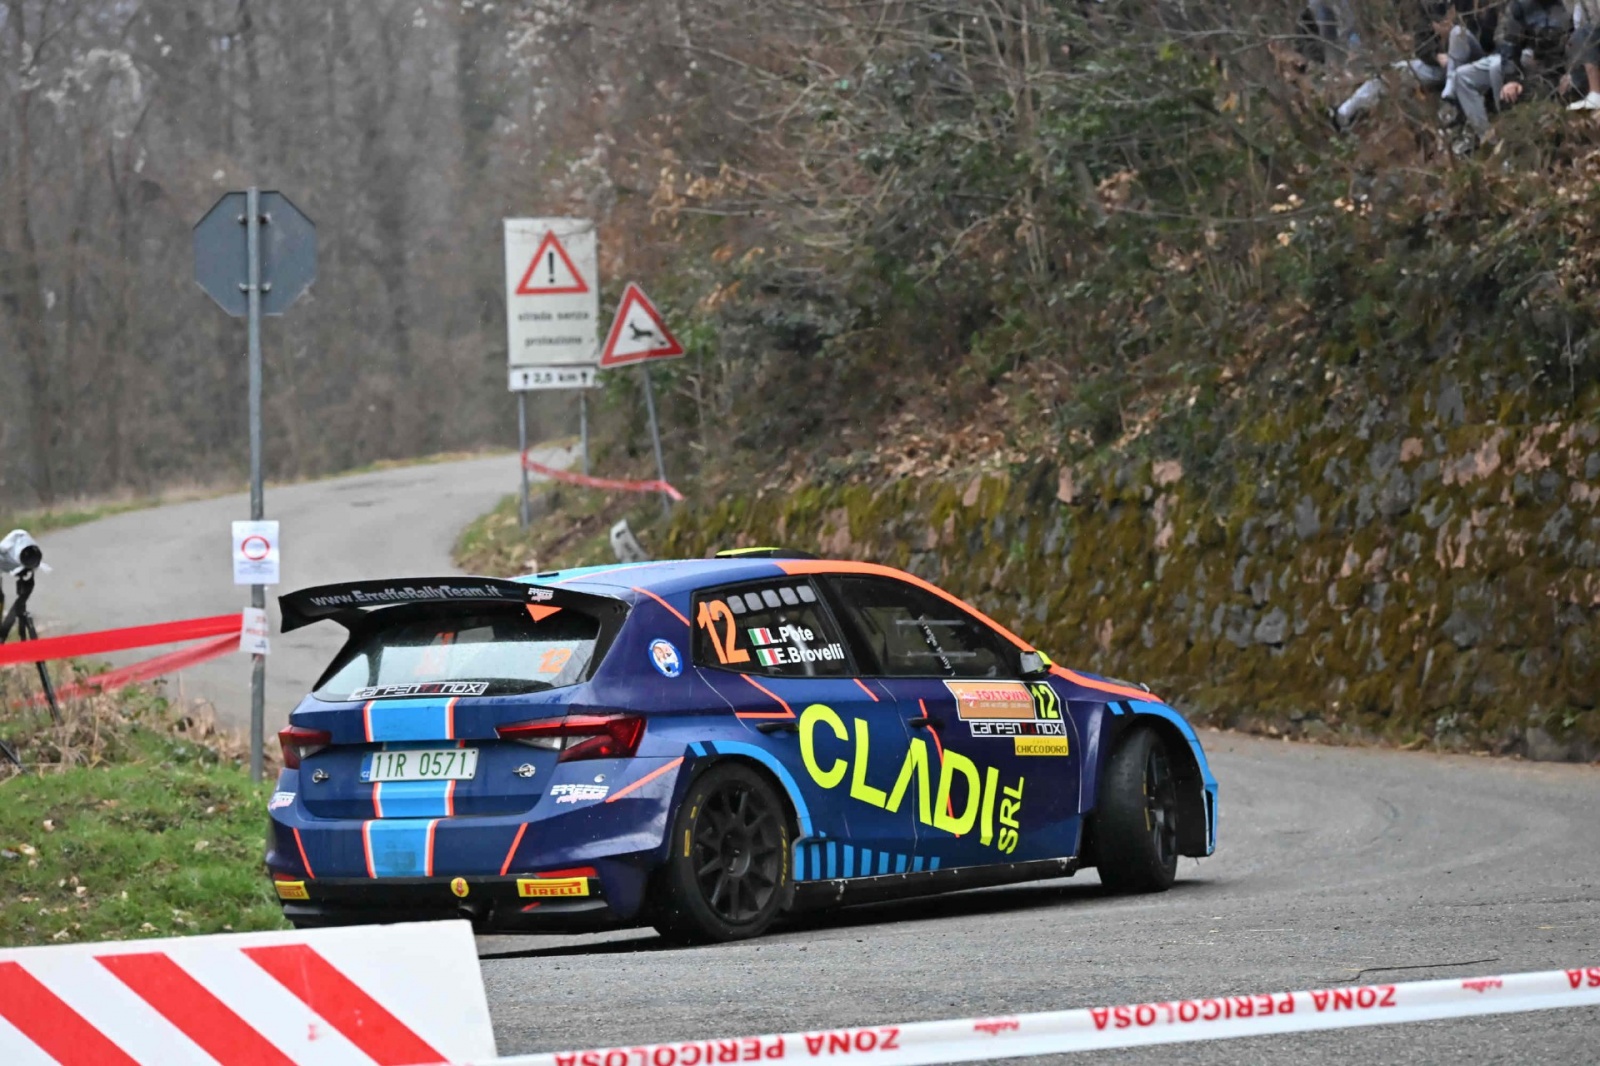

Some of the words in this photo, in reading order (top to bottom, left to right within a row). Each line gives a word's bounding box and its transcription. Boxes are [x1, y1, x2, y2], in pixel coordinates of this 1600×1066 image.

[310, 585, 503, 606] www.ErreffeRallyTeam.it
[697, 600, 750, 664] 12
[538, 648, 572, 674] 12
[774, 643, 845, 664] E.Brovelli
[976, 690, 1031, 702] FOXTOWN
[1031, 684, 1059, 718] 12
[1016, 745, 1044, 754] CHICCO
[375, 753, 408, 778] 11R
[419, 752, 467, 776] 0571
[799, 704, 999, 846] CLADI
[998, 777, 1025, 854] SRL
[524, 882, 582, 896] PIRELLI
[1311, 985, 1396, 1011] ZONA
[1089, 993, 1296, 1030] PERICOLOSA
[804, 1028, 900, 1057] ZONA
